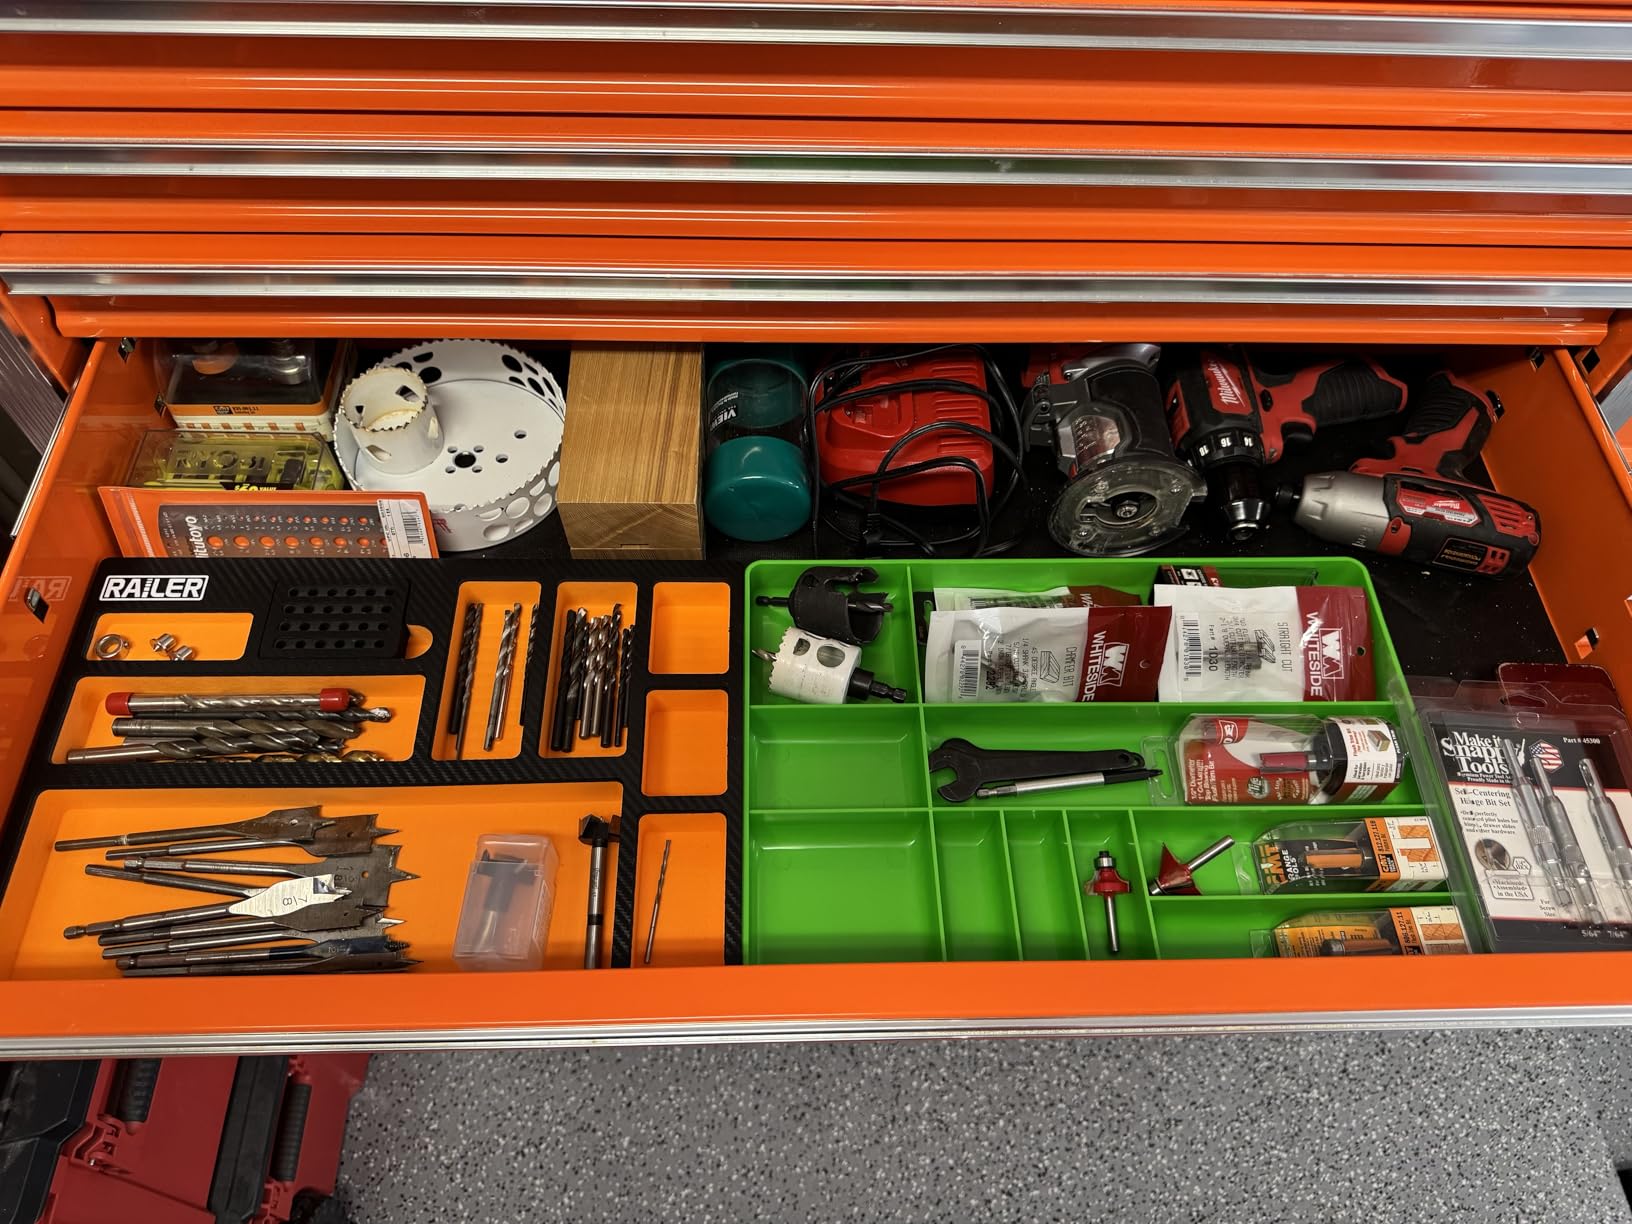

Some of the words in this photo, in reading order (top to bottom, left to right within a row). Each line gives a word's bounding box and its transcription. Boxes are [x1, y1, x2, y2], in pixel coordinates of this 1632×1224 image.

[103, 578, 205, 599] RAILER
[1277, 621, 1292, 657] STRAIGHT
[1081, 630, 1107, 702] WHITESIDE
[1281, 659, 1293, 673] CUT
[1452, 731, 1492, 748] Make
[1492, 734, 1502, 748] it
[1455, 756, 1510, 775] Tools
[1485, 798, 1497, 806] Bit
